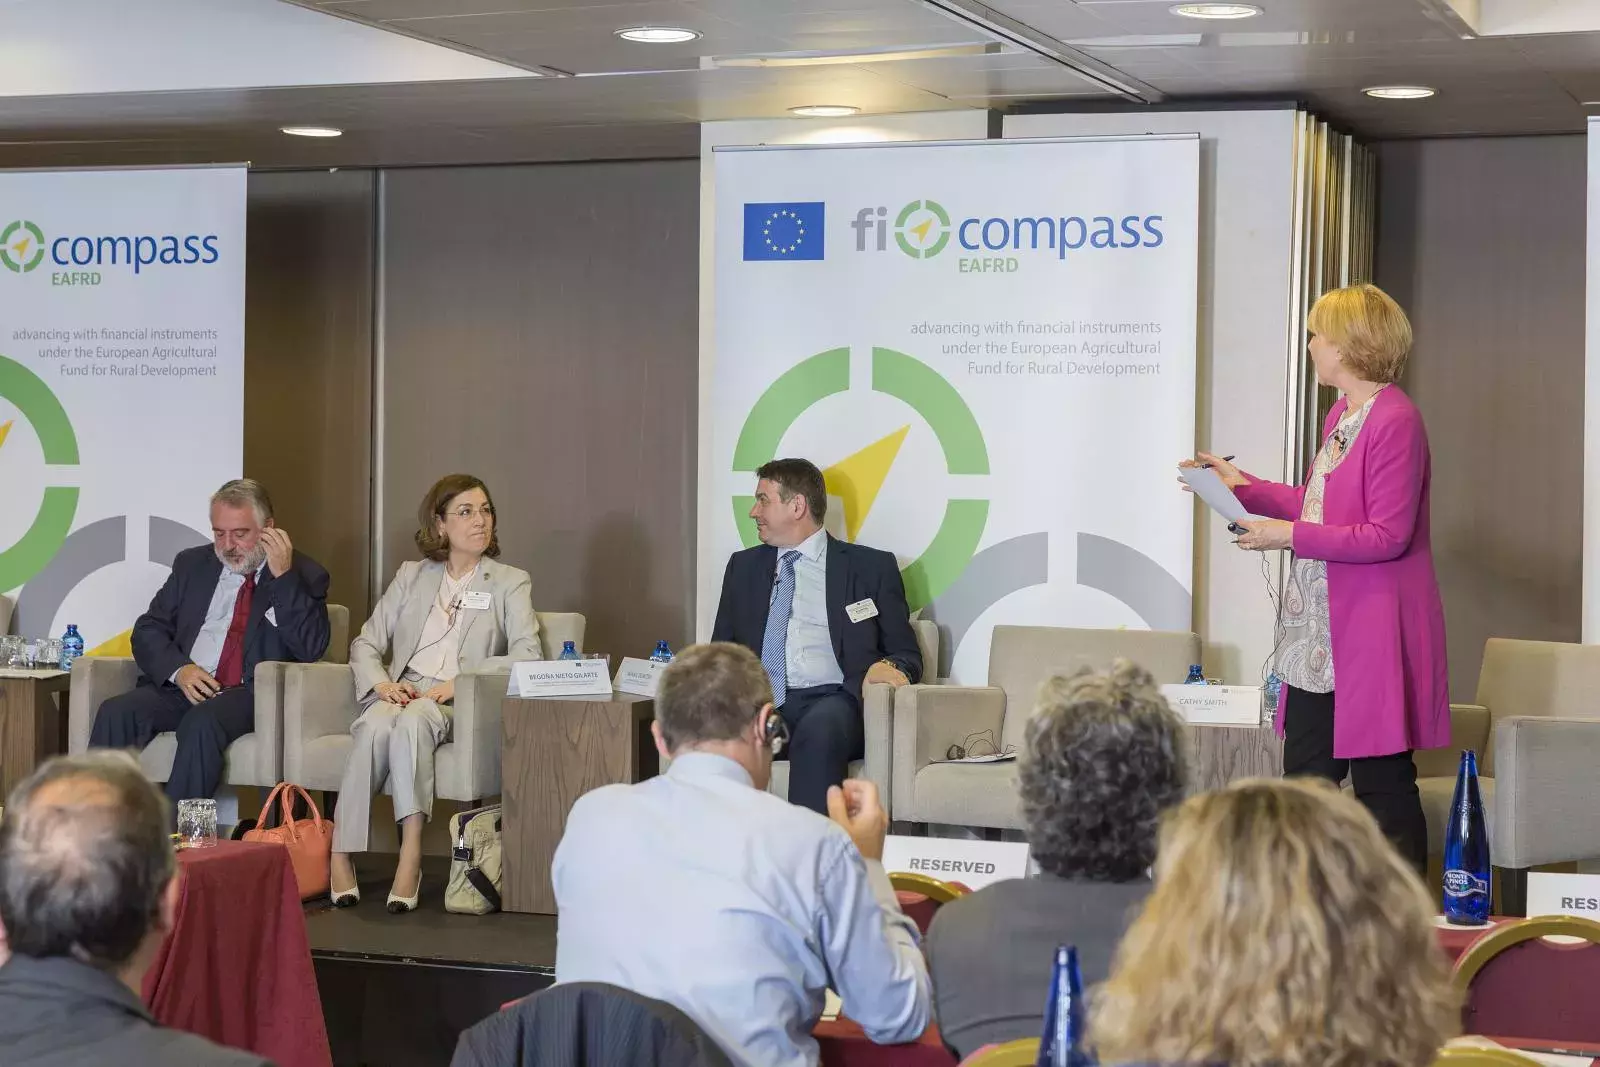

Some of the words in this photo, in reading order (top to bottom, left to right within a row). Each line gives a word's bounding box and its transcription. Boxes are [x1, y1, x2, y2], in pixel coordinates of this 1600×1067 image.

[850, 206, 887, 251] fi
[958, 215, 1164, 260] compass
[52, 235, 219, 274] compass
[958, 258, 1018, 273] EAFRD
[52, 272, 101, 286] EAFRD
[12, 328, 70, 342] advancing
[73, 328, 98, 340] with
[101, 328, 148, 340] financial
[150, 328, 218, 340] instruments
[910, 321, 980, 336] advancing
[984, 321, 1014, 334] with
[1016, 320, 1075, 334] financial
[1079, 321, 1162, 335] instruments
[39, 346, 72, 357] under
[75, 346, 93, 357] the
[96, 347, 149, 360] European
[152, 346, 217, 360] Agricultural
[942, 341, 981, 355] under
[984, 341, 1008, 355] the
[1011, 342, 1077, 358] European
[1081, 341, 1161, 358] Agricultural
[60, 365, 89, 376] Fund
[92, 364, 106, 376] for
[110, 364, 138, 376] Rural
[141, 364, 217, 378] Development
[968, 361, 1002, 375] Fund
[1005, 361, 1025, 375] for
[1028, 361, 1063, 375] Rural
[1067, 361, 1160, 378] Development
[1204, 698, 1228, 706] SMITH
[909, 858, 996, 875] RESERVED
[1561, 896, 1600, 911] RES
